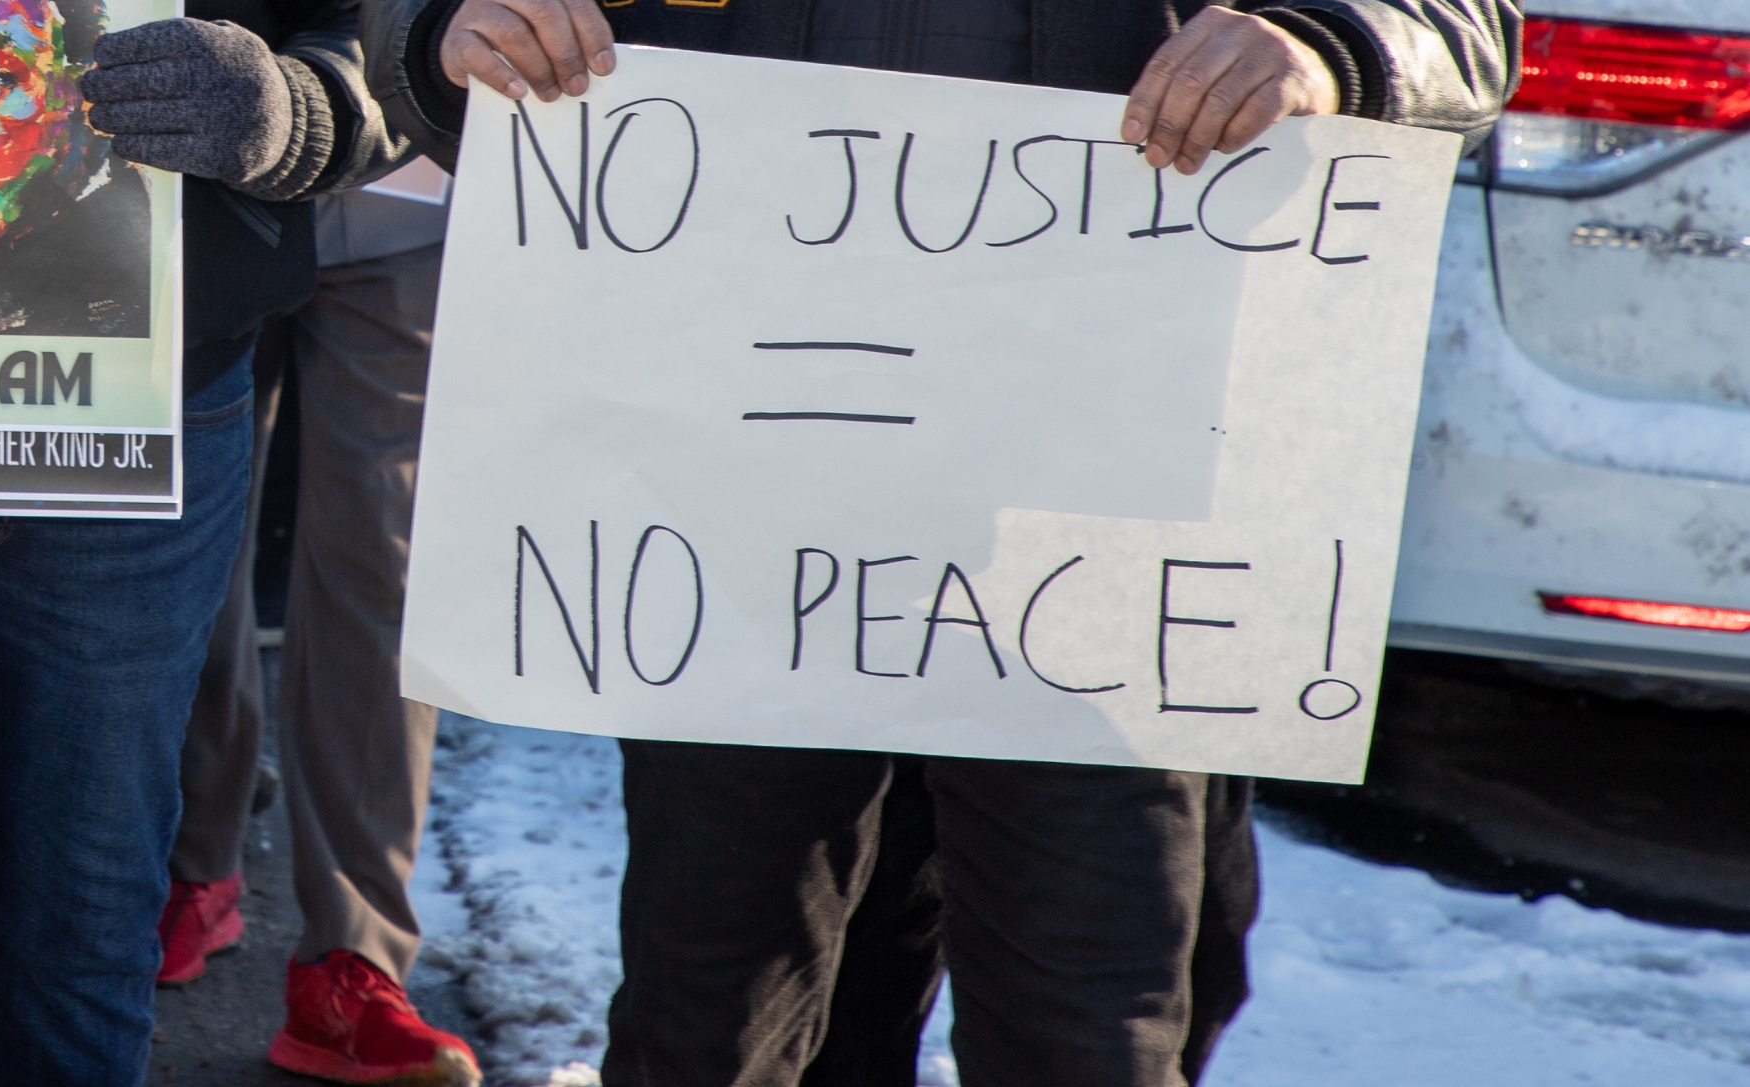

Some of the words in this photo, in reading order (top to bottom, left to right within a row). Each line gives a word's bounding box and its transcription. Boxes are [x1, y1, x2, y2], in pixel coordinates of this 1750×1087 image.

[508, 97, 700, 254] NO
[785, 128, 1392, 265] JUSTICE
[45, 434, 105, 468] KING
[113, 436, 154, 470] JR.
[513, 519, 705, 695] NO
